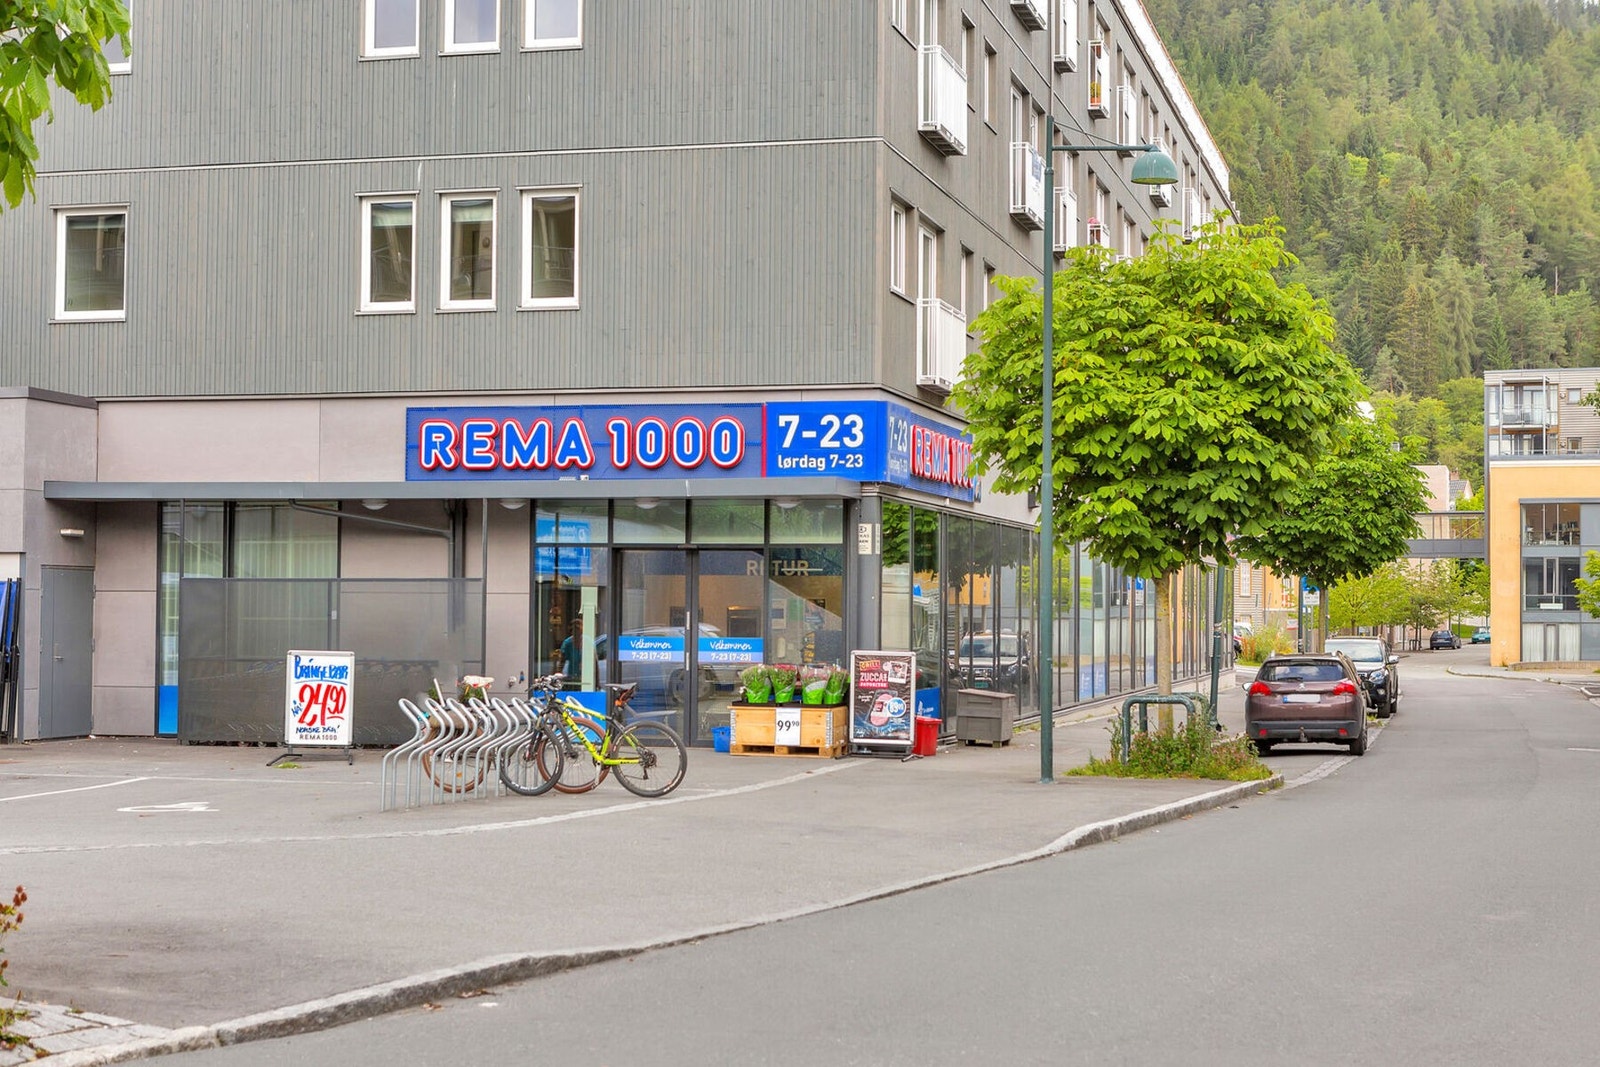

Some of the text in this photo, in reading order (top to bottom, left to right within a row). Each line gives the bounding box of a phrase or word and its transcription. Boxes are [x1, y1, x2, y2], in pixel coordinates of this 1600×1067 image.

[778, 414, 864, 448] 7-23
[889, 416, 908, 452] 7-23
[419, 415, 745, 470] REMA 1000
[777, 454, 863, 471] lørdag 7-23
[910, 425, 951, 483] REMA
[630, 638, 672, 649] Velkommen
[709, 640, 752, 650] Velkommen
[631, 652, 648, 660] 7-23
[711, 653, 728, 661] 7-23
